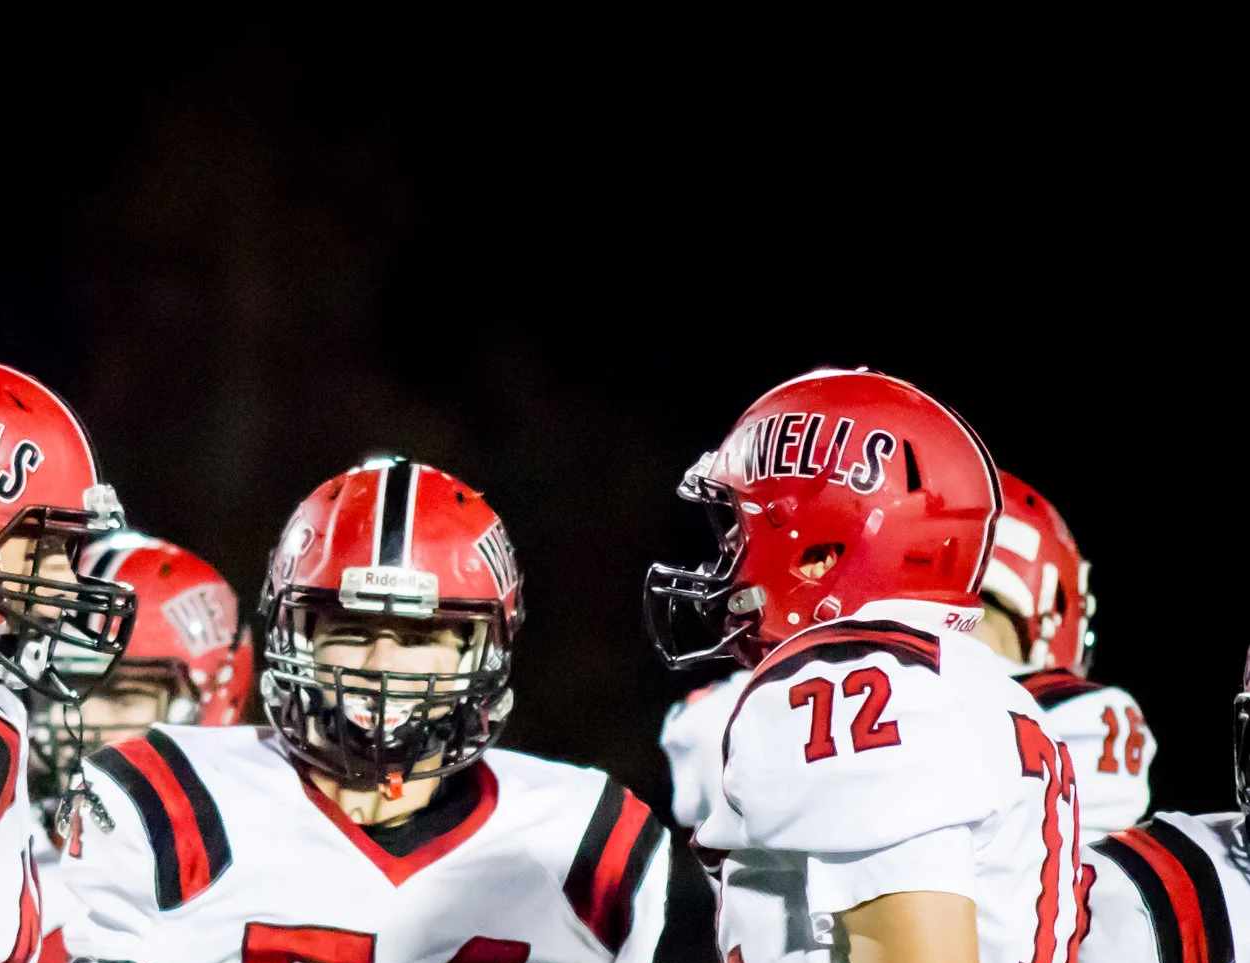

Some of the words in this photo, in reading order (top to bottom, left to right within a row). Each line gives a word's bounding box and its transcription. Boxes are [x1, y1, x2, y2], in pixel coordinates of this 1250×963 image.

[743, 412, 897, 495] WELLS
[365, 571, 417, 587] Riddll
[789, 666, 901, 764] 72
[1097, 706, 1145, 776] 16
